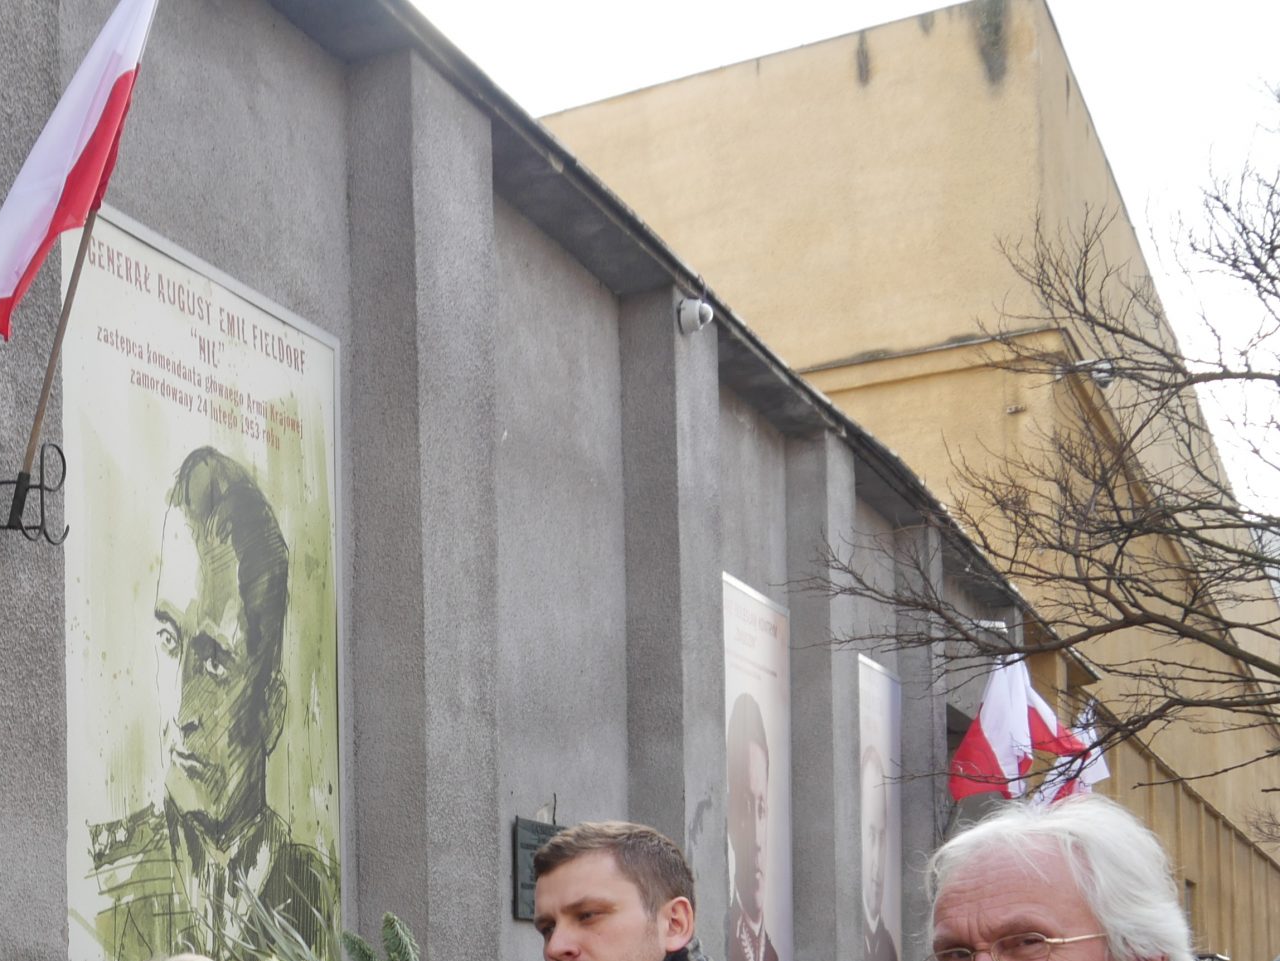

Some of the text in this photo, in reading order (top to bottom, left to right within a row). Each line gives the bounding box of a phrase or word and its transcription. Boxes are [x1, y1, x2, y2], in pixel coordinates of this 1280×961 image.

[87, 235, 307, 376] GENERAŁ AUGUST EMIL FIELDORF
[96, 325, 145, 359] zastępca
[146, 343, 203, 388] komendanta
[246, 392, 269, 419] Armii
[269, 403, 305, 440] Krajowej
[130, 367, 195, 413] zamordowany
[196, 394, 209, 417] 24
[210, 401, 238, 430] lutego
[240, 415, 261, 441] 1953
